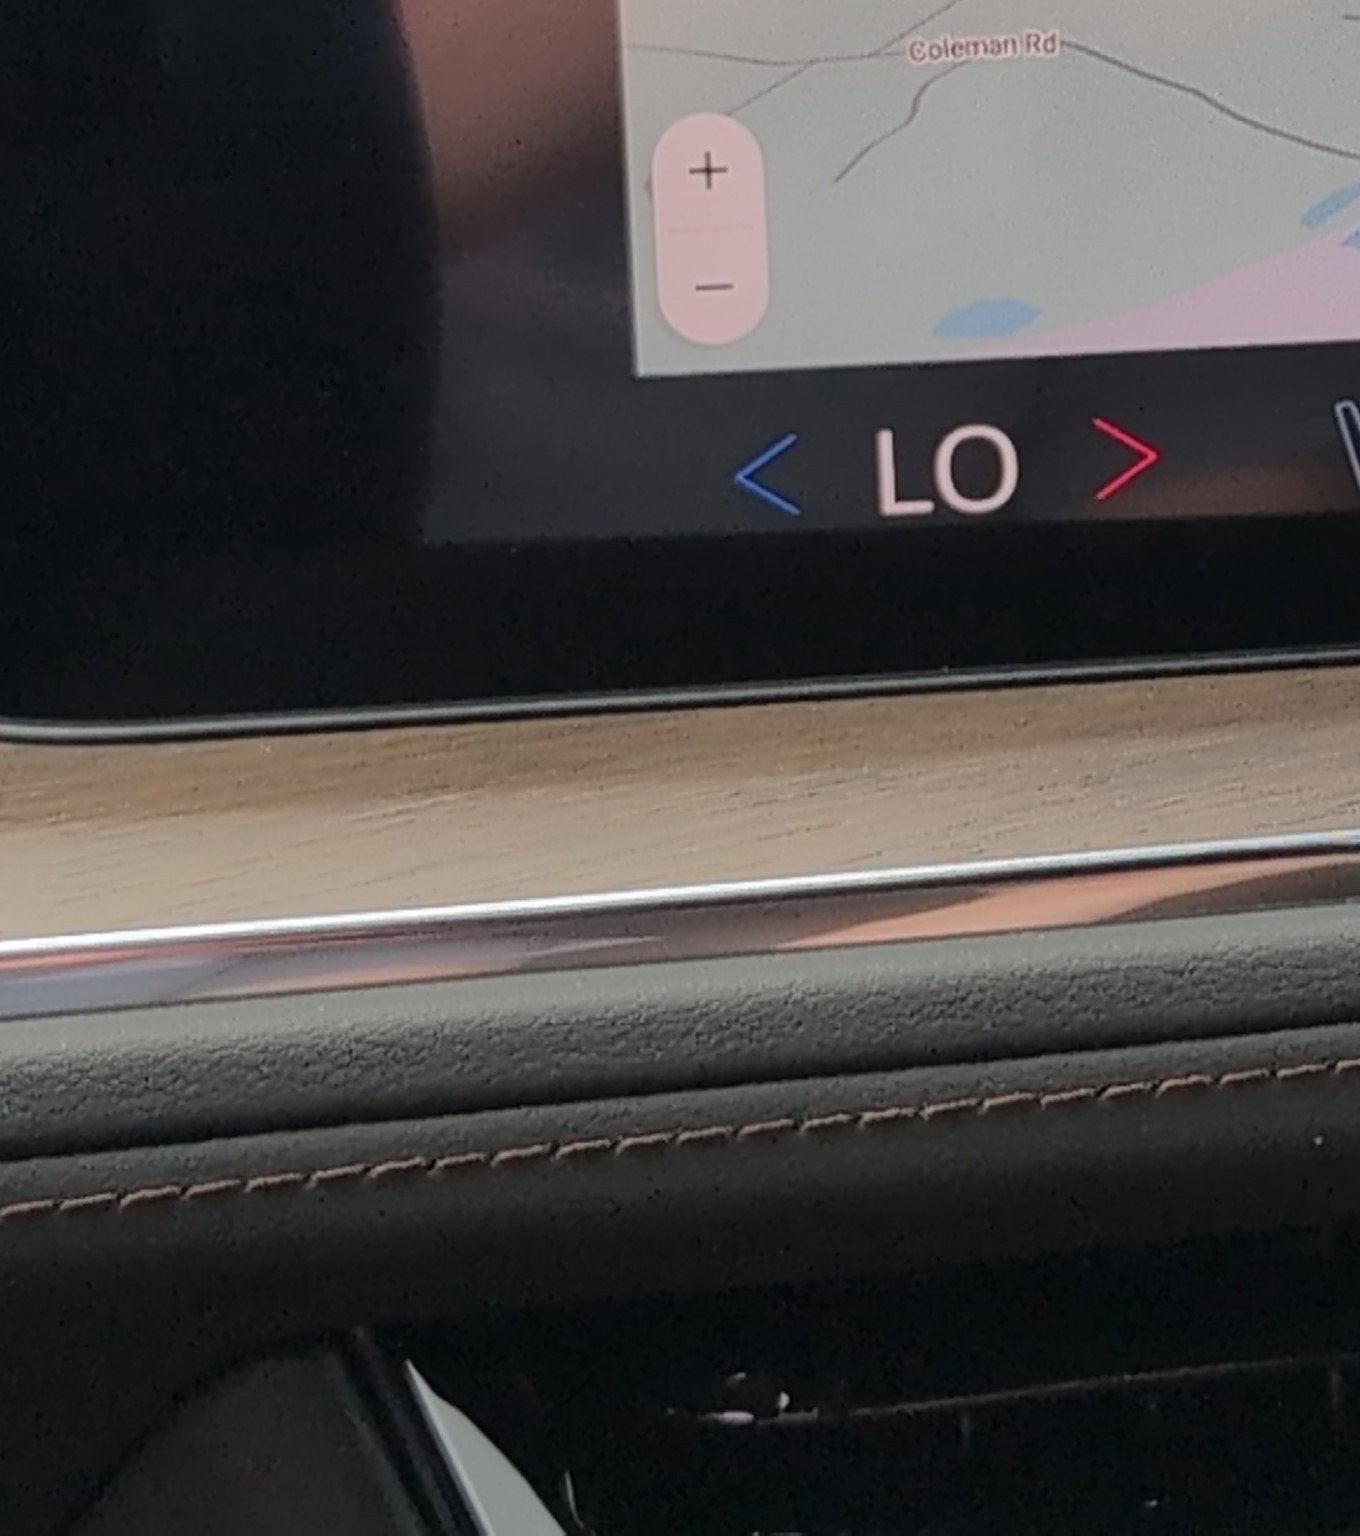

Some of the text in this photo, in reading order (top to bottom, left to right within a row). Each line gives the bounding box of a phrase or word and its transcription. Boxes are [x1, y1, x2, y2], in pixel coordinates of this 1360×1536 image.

[909, 32, 1056, 63] Coleman Rd
[875, 424, 1020, 518] LO
